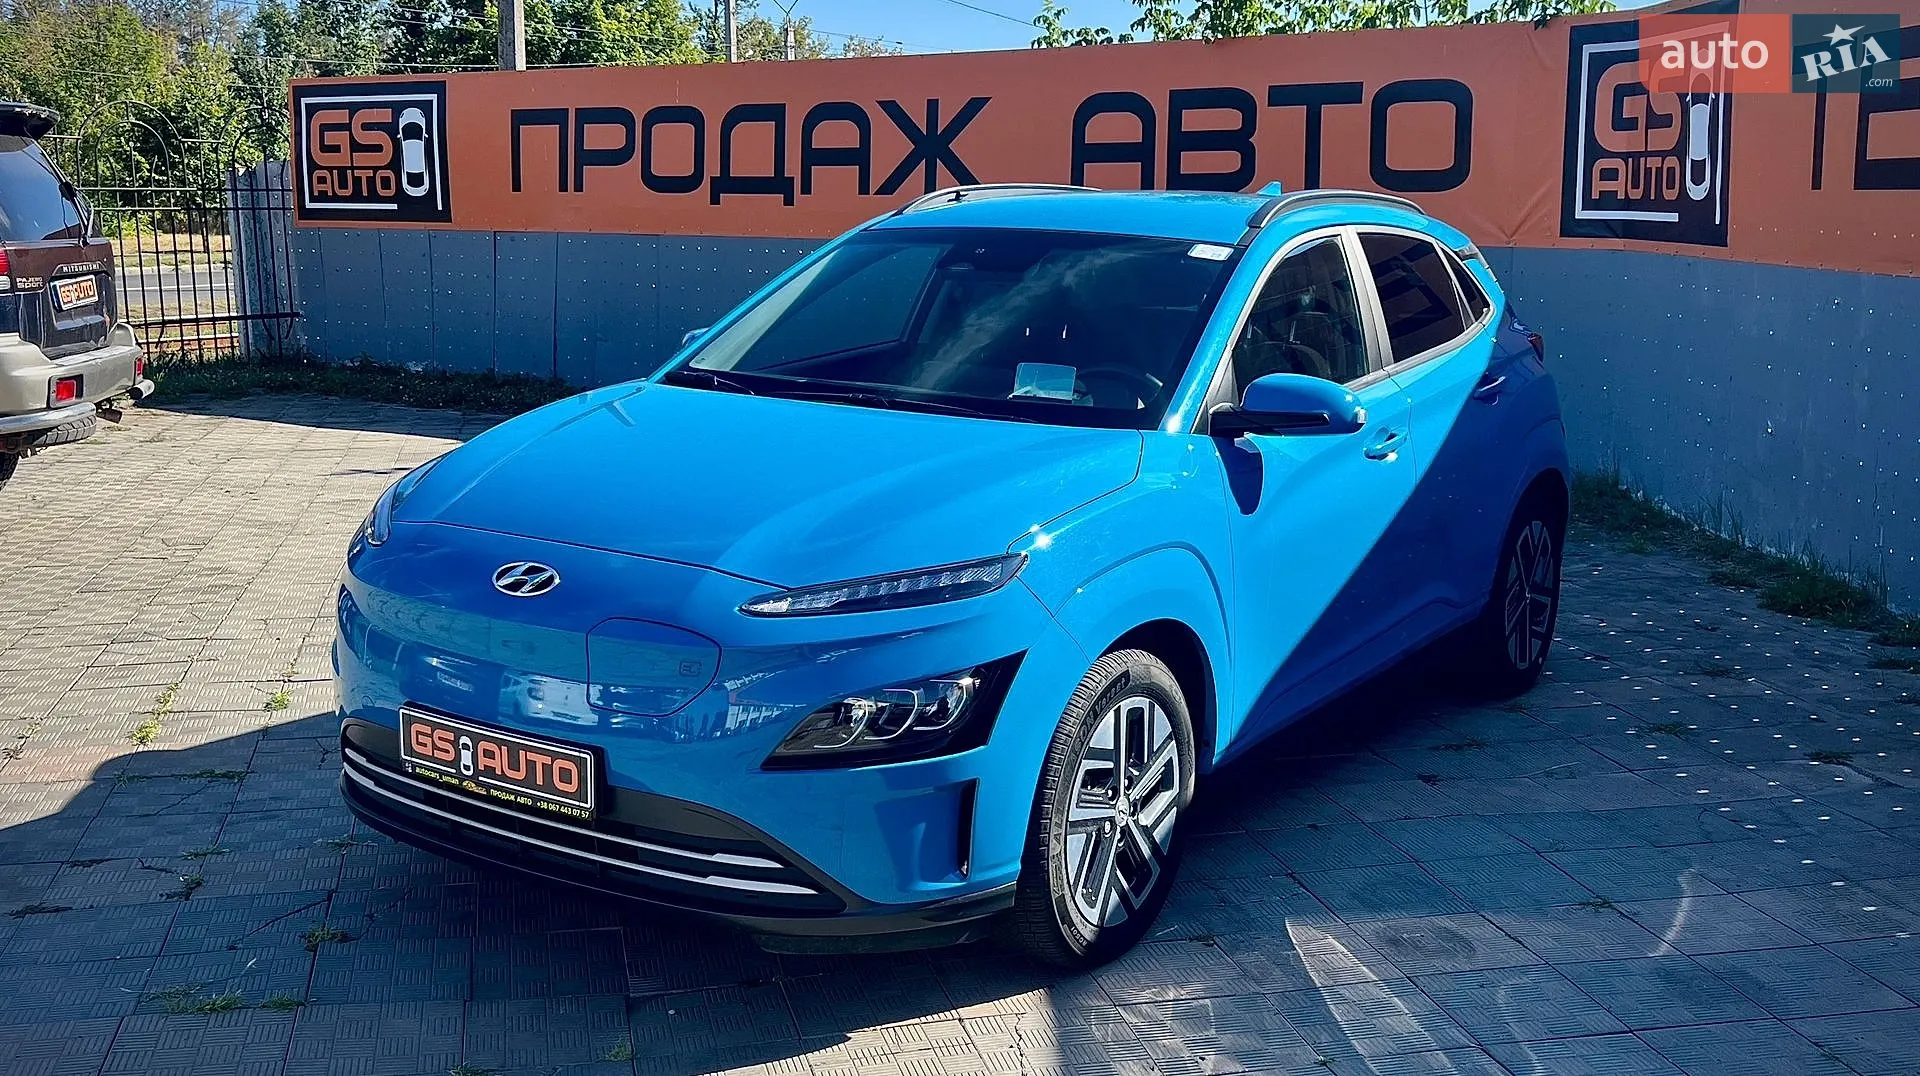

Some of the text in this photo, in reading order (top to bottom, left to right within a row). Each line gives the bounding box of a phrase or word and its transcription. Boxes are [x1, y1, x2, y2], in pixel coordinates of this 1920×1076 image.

[1594, 57, 1684, 153] GS
[311, 108, 394, 167] GS
[510, 78, 1473, 207] ПРОДАЖ АВТО
[313, 169, 396, 197] AUTO
[1591, 156, 1681, 201] AUTO
[63, 263, 100, 273] MITSUBISHI
[410, 722, 579, 793] GS AUTO
[415, 766, 459, 784] autocars_uman
[490, 788, 533, 806] ПРОДАЖ АВТО
[537, 801, 548, 809] +38
[560, 806, 572, 815] 443
[572, 809, 580, 817] 07
[581, 810, 590, 819] 57
